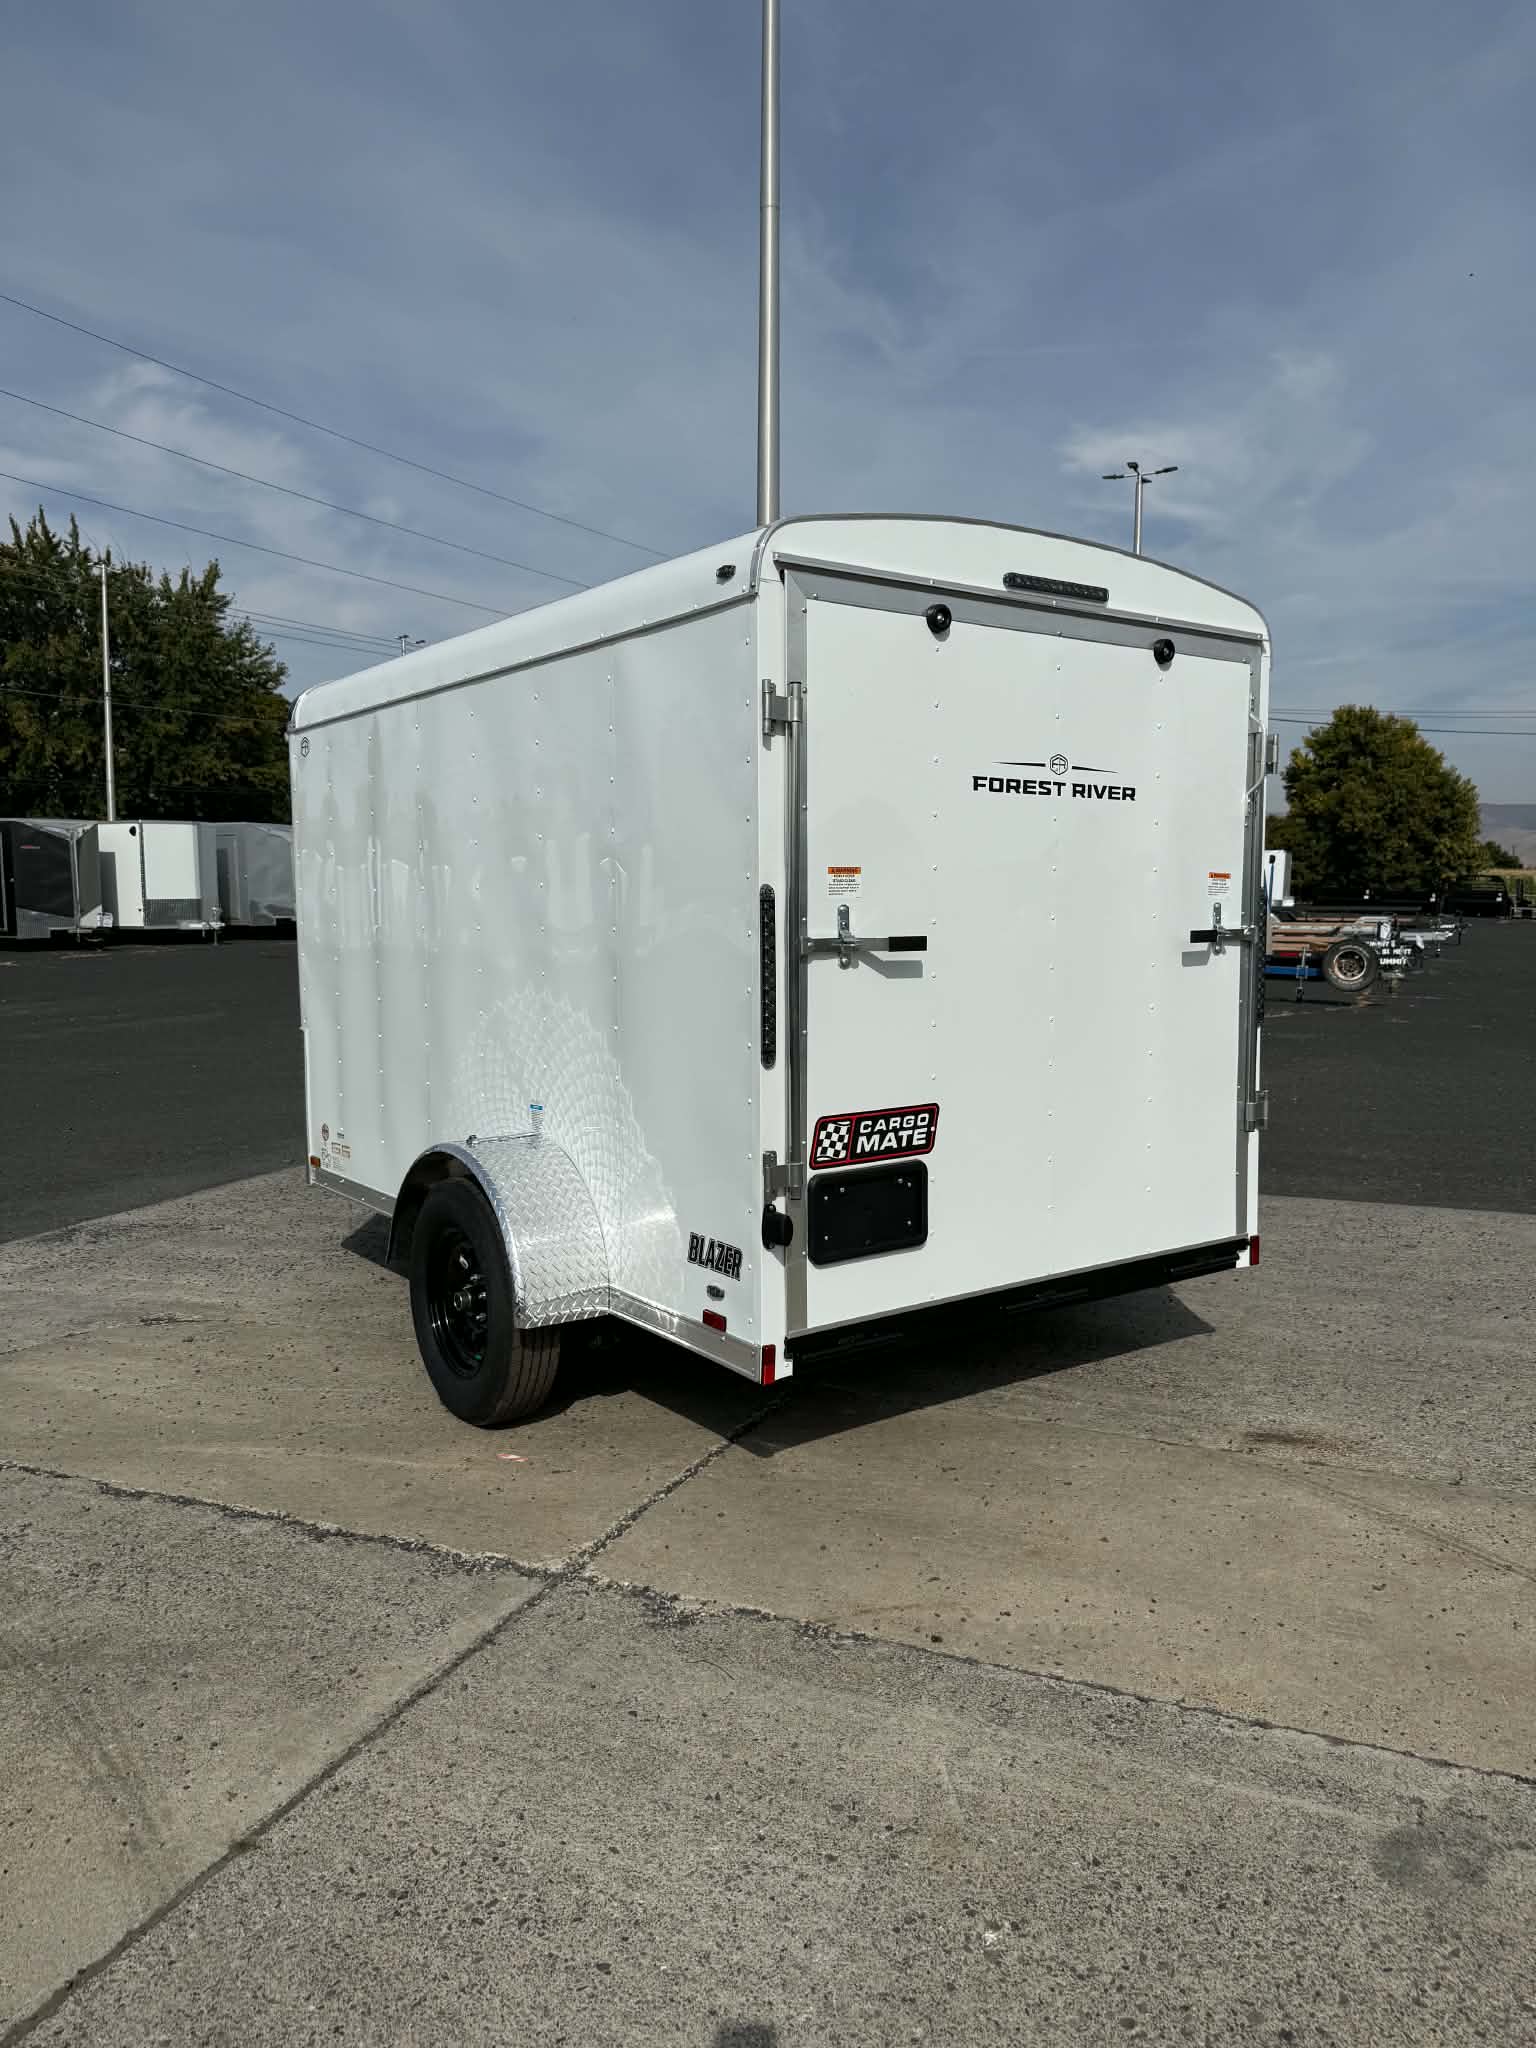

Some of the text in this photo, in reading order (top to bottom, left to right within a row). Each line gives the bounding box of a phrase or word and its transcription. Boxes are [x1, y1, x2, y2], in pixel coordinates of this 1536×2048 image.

[972, 775, 1137, 802] FOREST RIVER
[859, 1113, 930, 1134] CARGO
[856, 1127, 928, 1154] MATE
[687, 1231, 743, 1282] BLAZER
